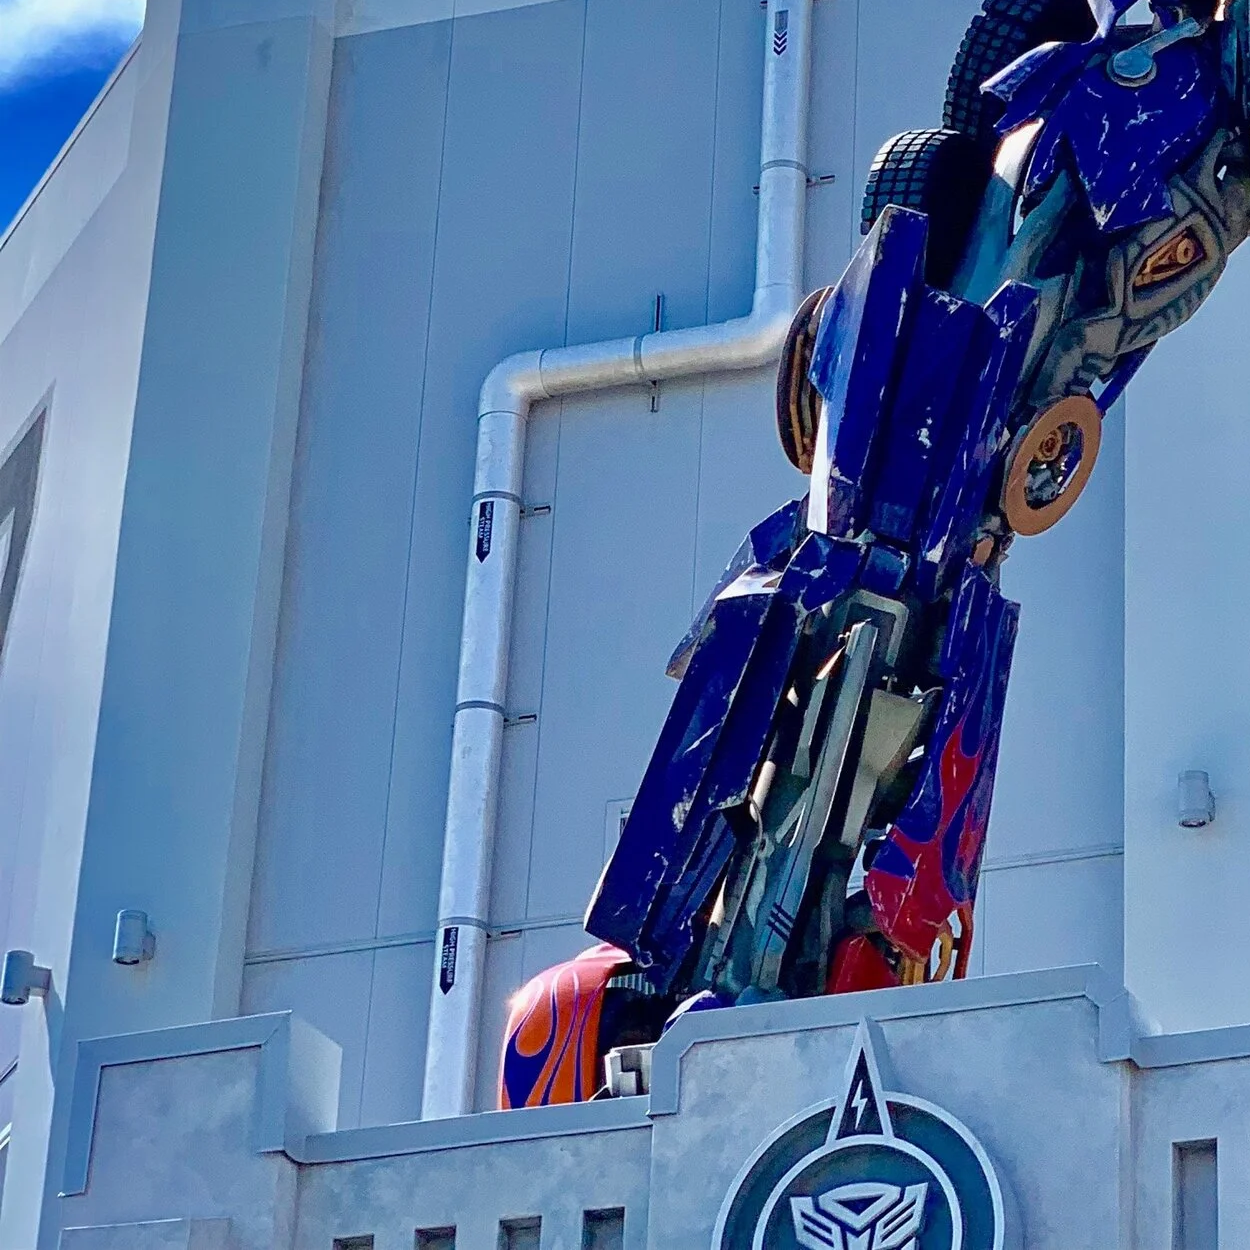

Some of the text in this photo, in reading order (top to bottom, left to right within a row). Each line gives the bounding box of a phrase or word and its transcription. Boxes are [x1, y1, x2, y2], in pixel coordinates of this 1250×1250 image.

[482, 520, 491, 552] PRESSURE
[446, 928, 457, 983] HIGH PRESSURE
